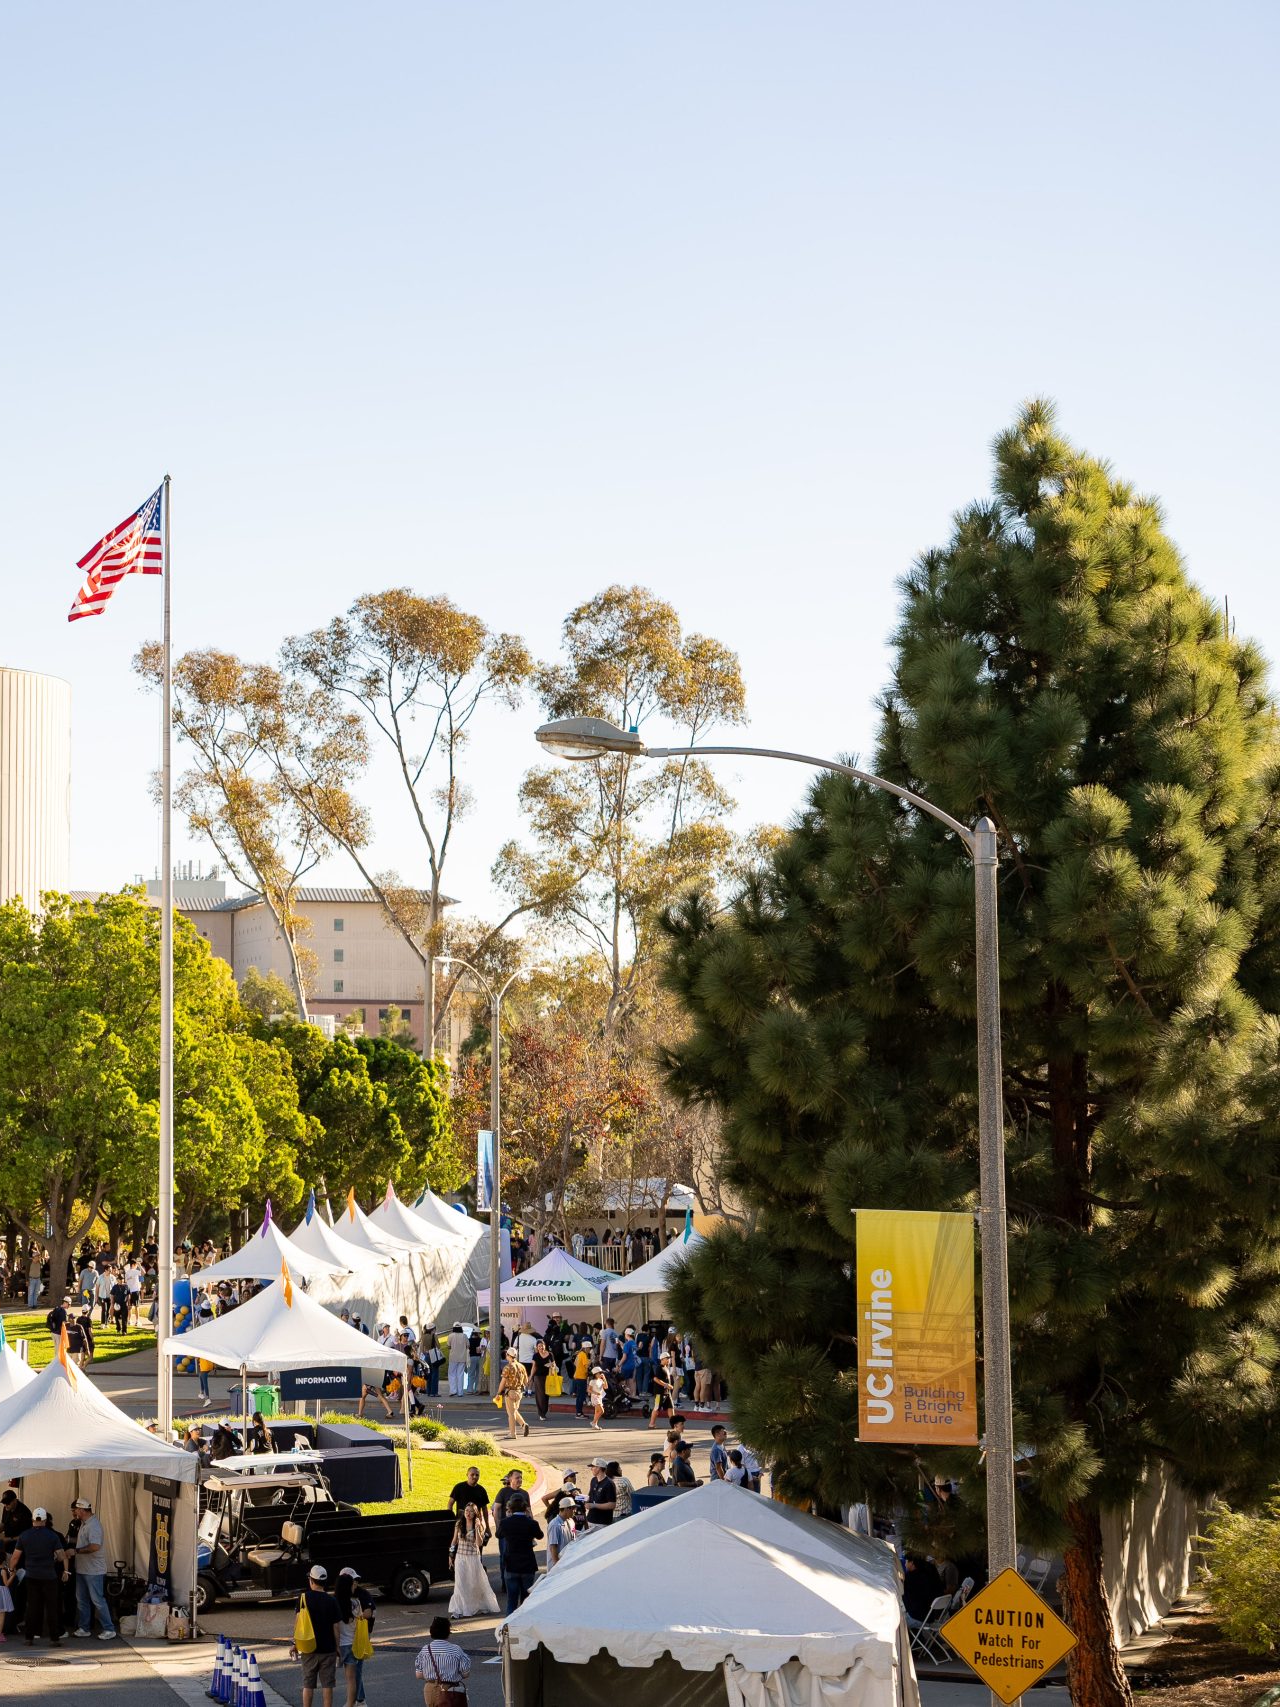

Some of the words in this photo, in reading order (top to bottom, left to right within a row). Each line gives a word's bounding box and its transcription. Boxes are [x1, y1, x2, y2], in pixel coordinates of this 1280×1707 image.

[514, 1278, 572, 1287] Bloom
[527, 1294, 546, 1302] time
[547, 1294, 557, 1302] to
[556, 1293, 586, 1302] Bloom
[864, 1268, 894, 1368] Irvine
[295, 1376, 347, 1385] INFORMATION
[866, 1373, 895, 1425] UC
[904, 1386, 965, 1401] Building
[904, 1401, 912, 1411] a
[917, 1400, 963, 1414] Bright
[904, 1412, 953, 1425] Future
[974, 1608, 1045, 1629] CAUTION
[978, 1632, 1014, 1648] Watch
[1021, 1635, 1041, 1650] For
[974, 1651, 1045, 1670] Pedestrians
